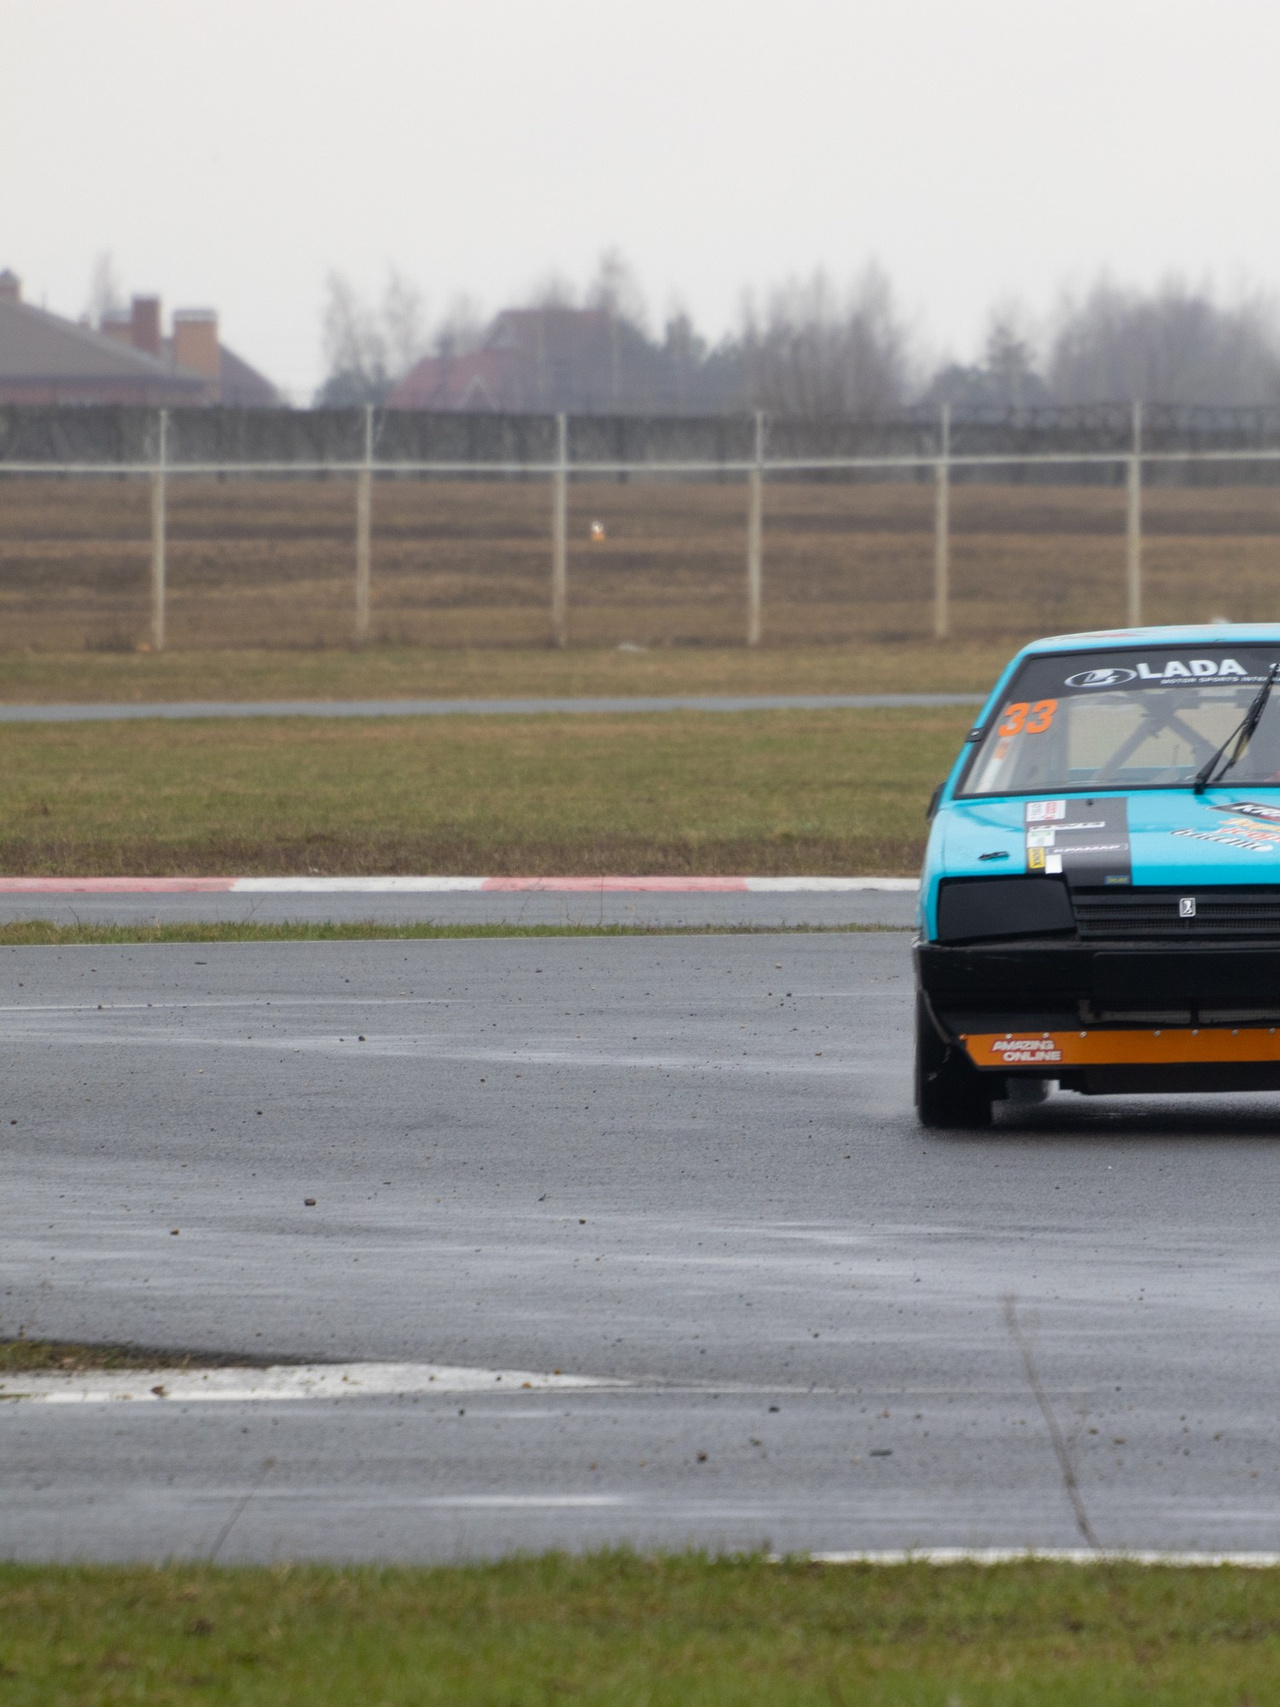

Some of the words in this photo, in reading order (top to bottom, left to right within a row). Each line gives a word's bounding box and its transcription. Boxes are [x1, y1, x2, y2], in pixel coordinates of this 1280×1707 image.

[1136, 658, 1248, 680] LADA
[998, 698, 1058, 738] 33
[992, 1040, 1055, 1051] AMAZING
[1002, 1051, 1062, 1062] ONLINE
